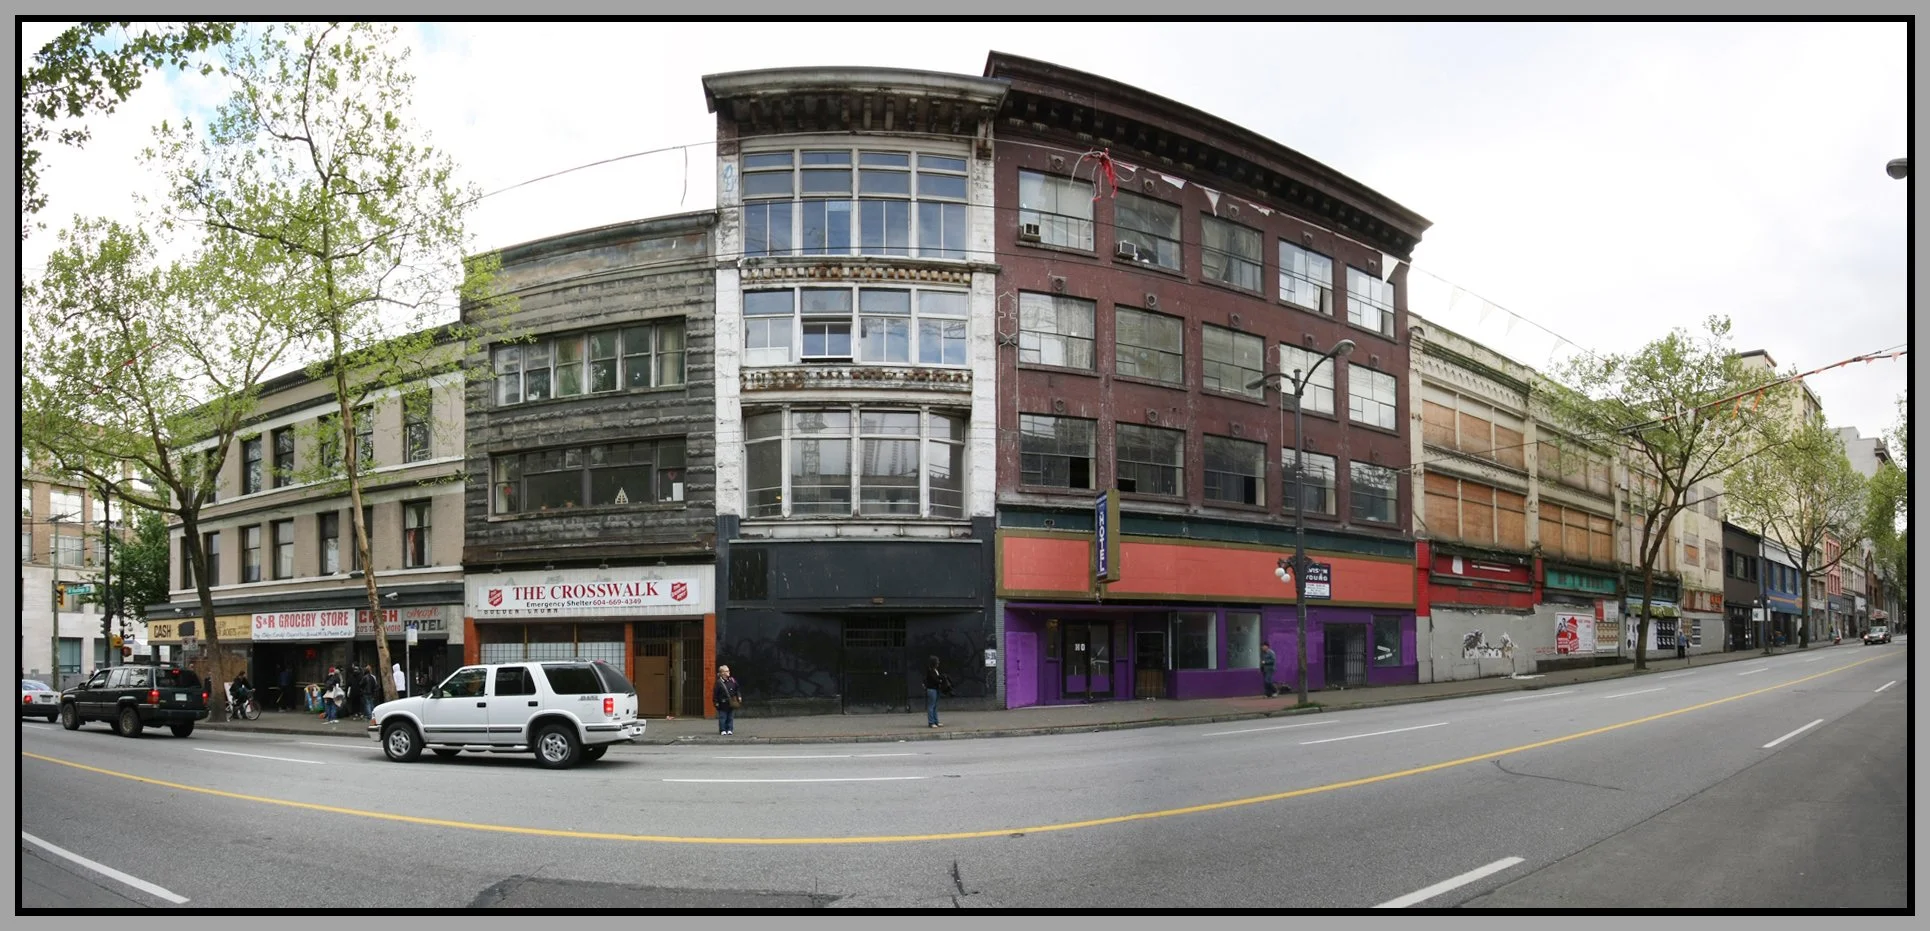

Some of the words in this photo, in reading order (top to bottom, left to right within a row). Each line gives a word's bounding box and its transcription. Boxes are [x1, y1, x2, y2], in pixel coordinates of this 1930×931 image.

[512, 586, 546, 600] THE
[550, 582, 659, 599] CROSSWALK
[593, 598, 642, 606] 604-669-4349
[256, 616, 275, 628] S&R
[279, 614, 317, 628] GROCERY
[321, 612, 349, 627] STORE
[404, 619, 444, 632] HOTEL
[154, 624, 171, 638] CASH
